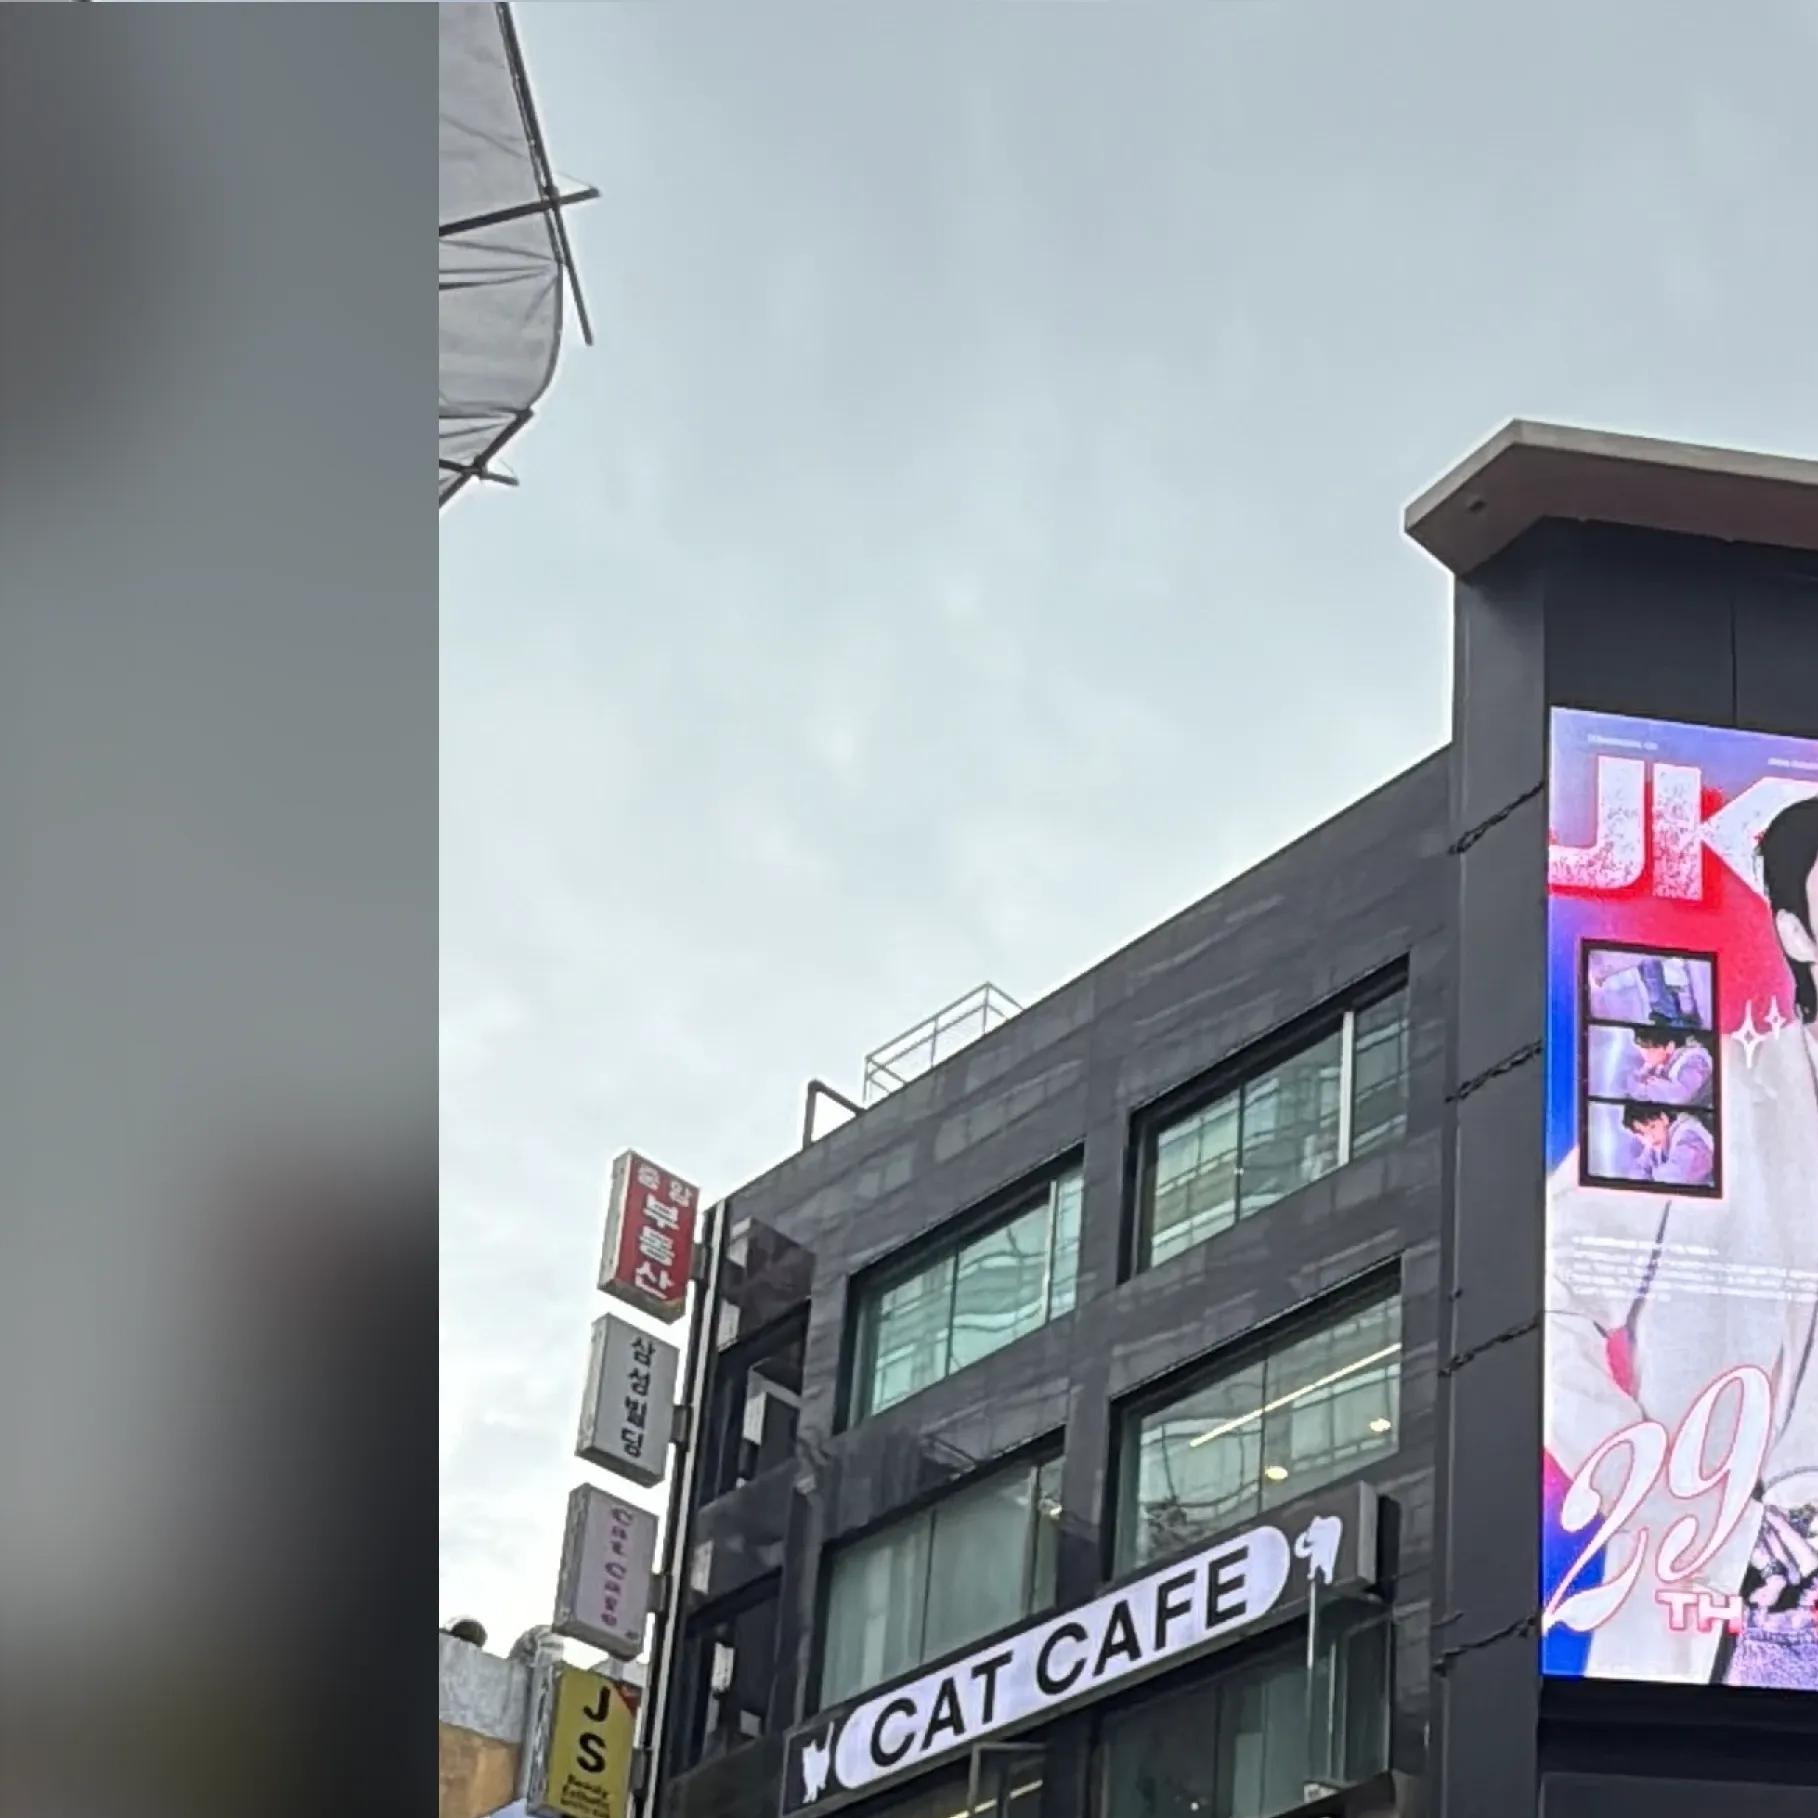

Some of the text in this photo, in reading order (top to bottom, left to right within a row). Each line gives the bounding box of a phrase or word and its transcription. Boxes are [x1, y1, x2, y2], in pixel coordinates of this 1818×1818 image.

[635, 1192, 680, 1300] 부동산
[620, 1335, 656, 1458] 삼성빌딩
[1541, 1364, 1773, 1634] 29
[870, 1544, 1250, 1769] CAT CAFE
[1655, 1588, 1744, 1634] TH
[575, 1684, 612, 1774] JS
